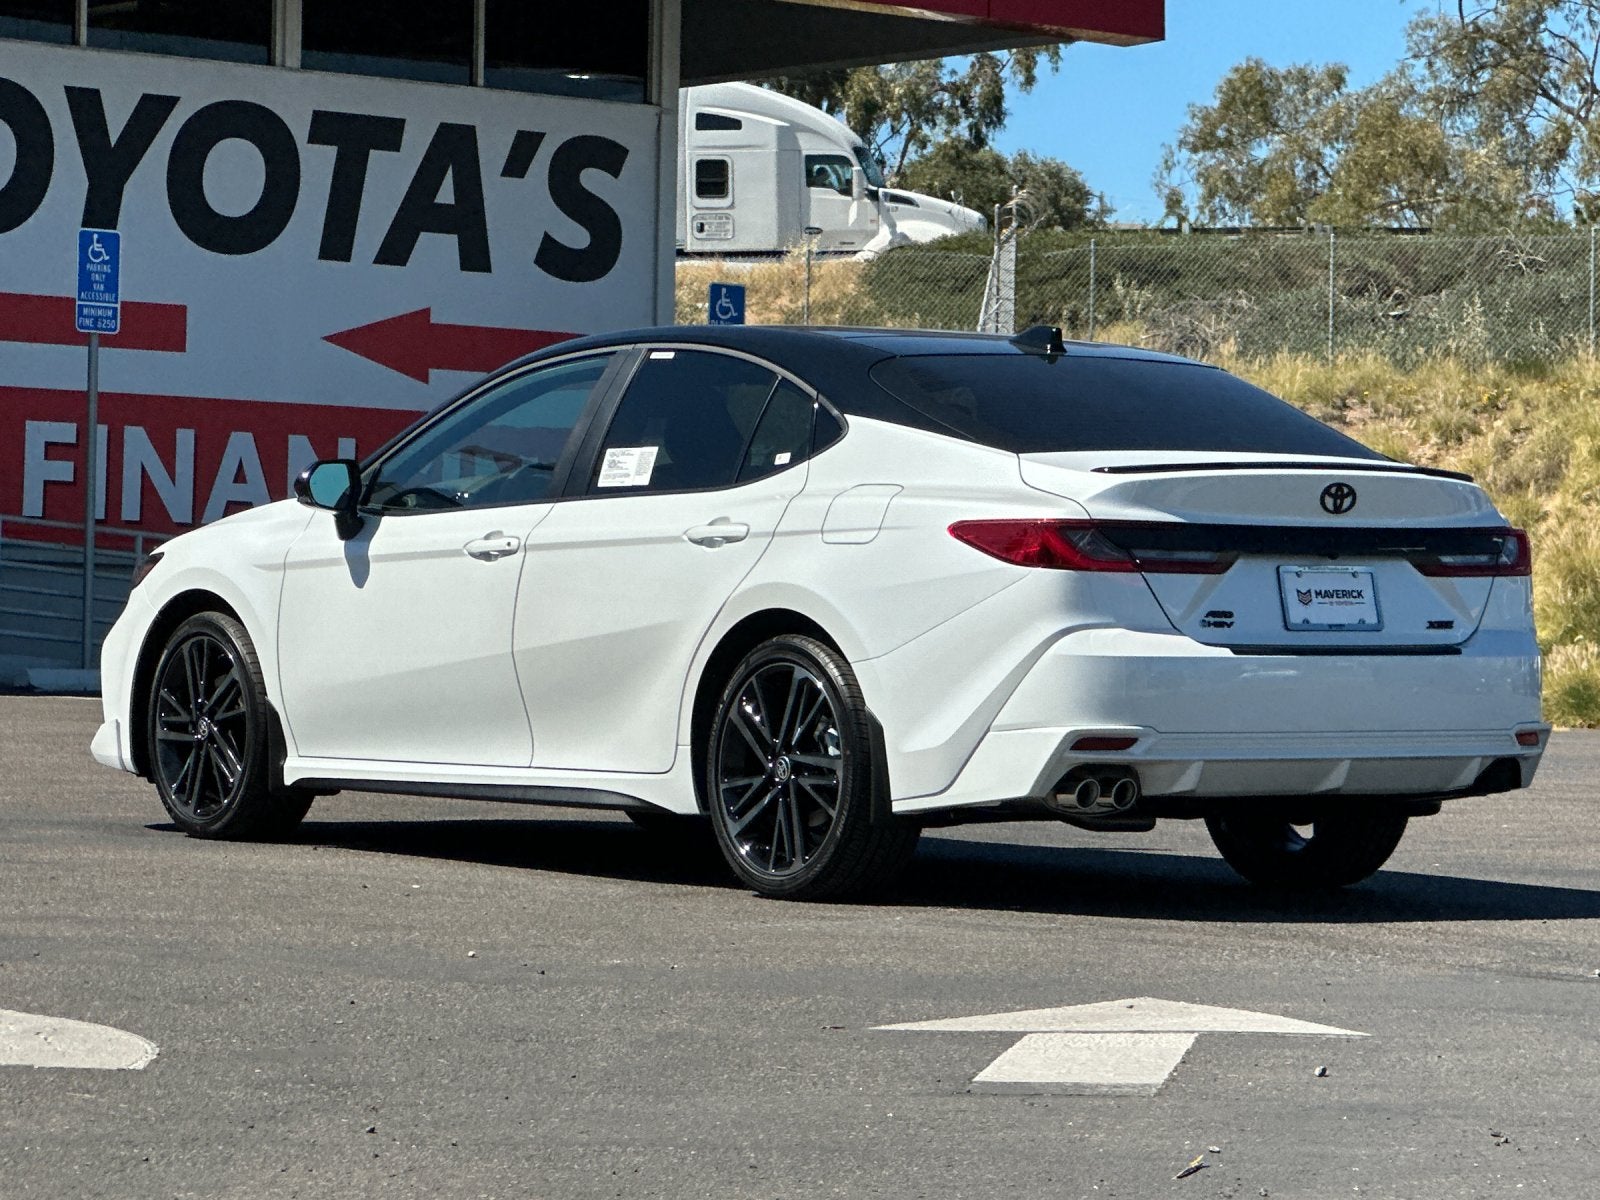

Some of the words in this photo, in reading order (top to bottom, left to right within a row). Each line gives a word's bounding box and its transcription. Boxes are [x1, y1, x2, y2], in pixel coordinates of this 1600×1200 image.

[86, 263, 111, 272] PARKING
[91, 273, 105, 282] ONLY
[93, 283, 105, 291] VAN
[80, 291, 115, 302] ACCESSIBLE
[82, 308, 112, 317] MINIMUM
[79, 318, 94, 327] FINE
[1314, 589, 1365, 599] MAVERICK
